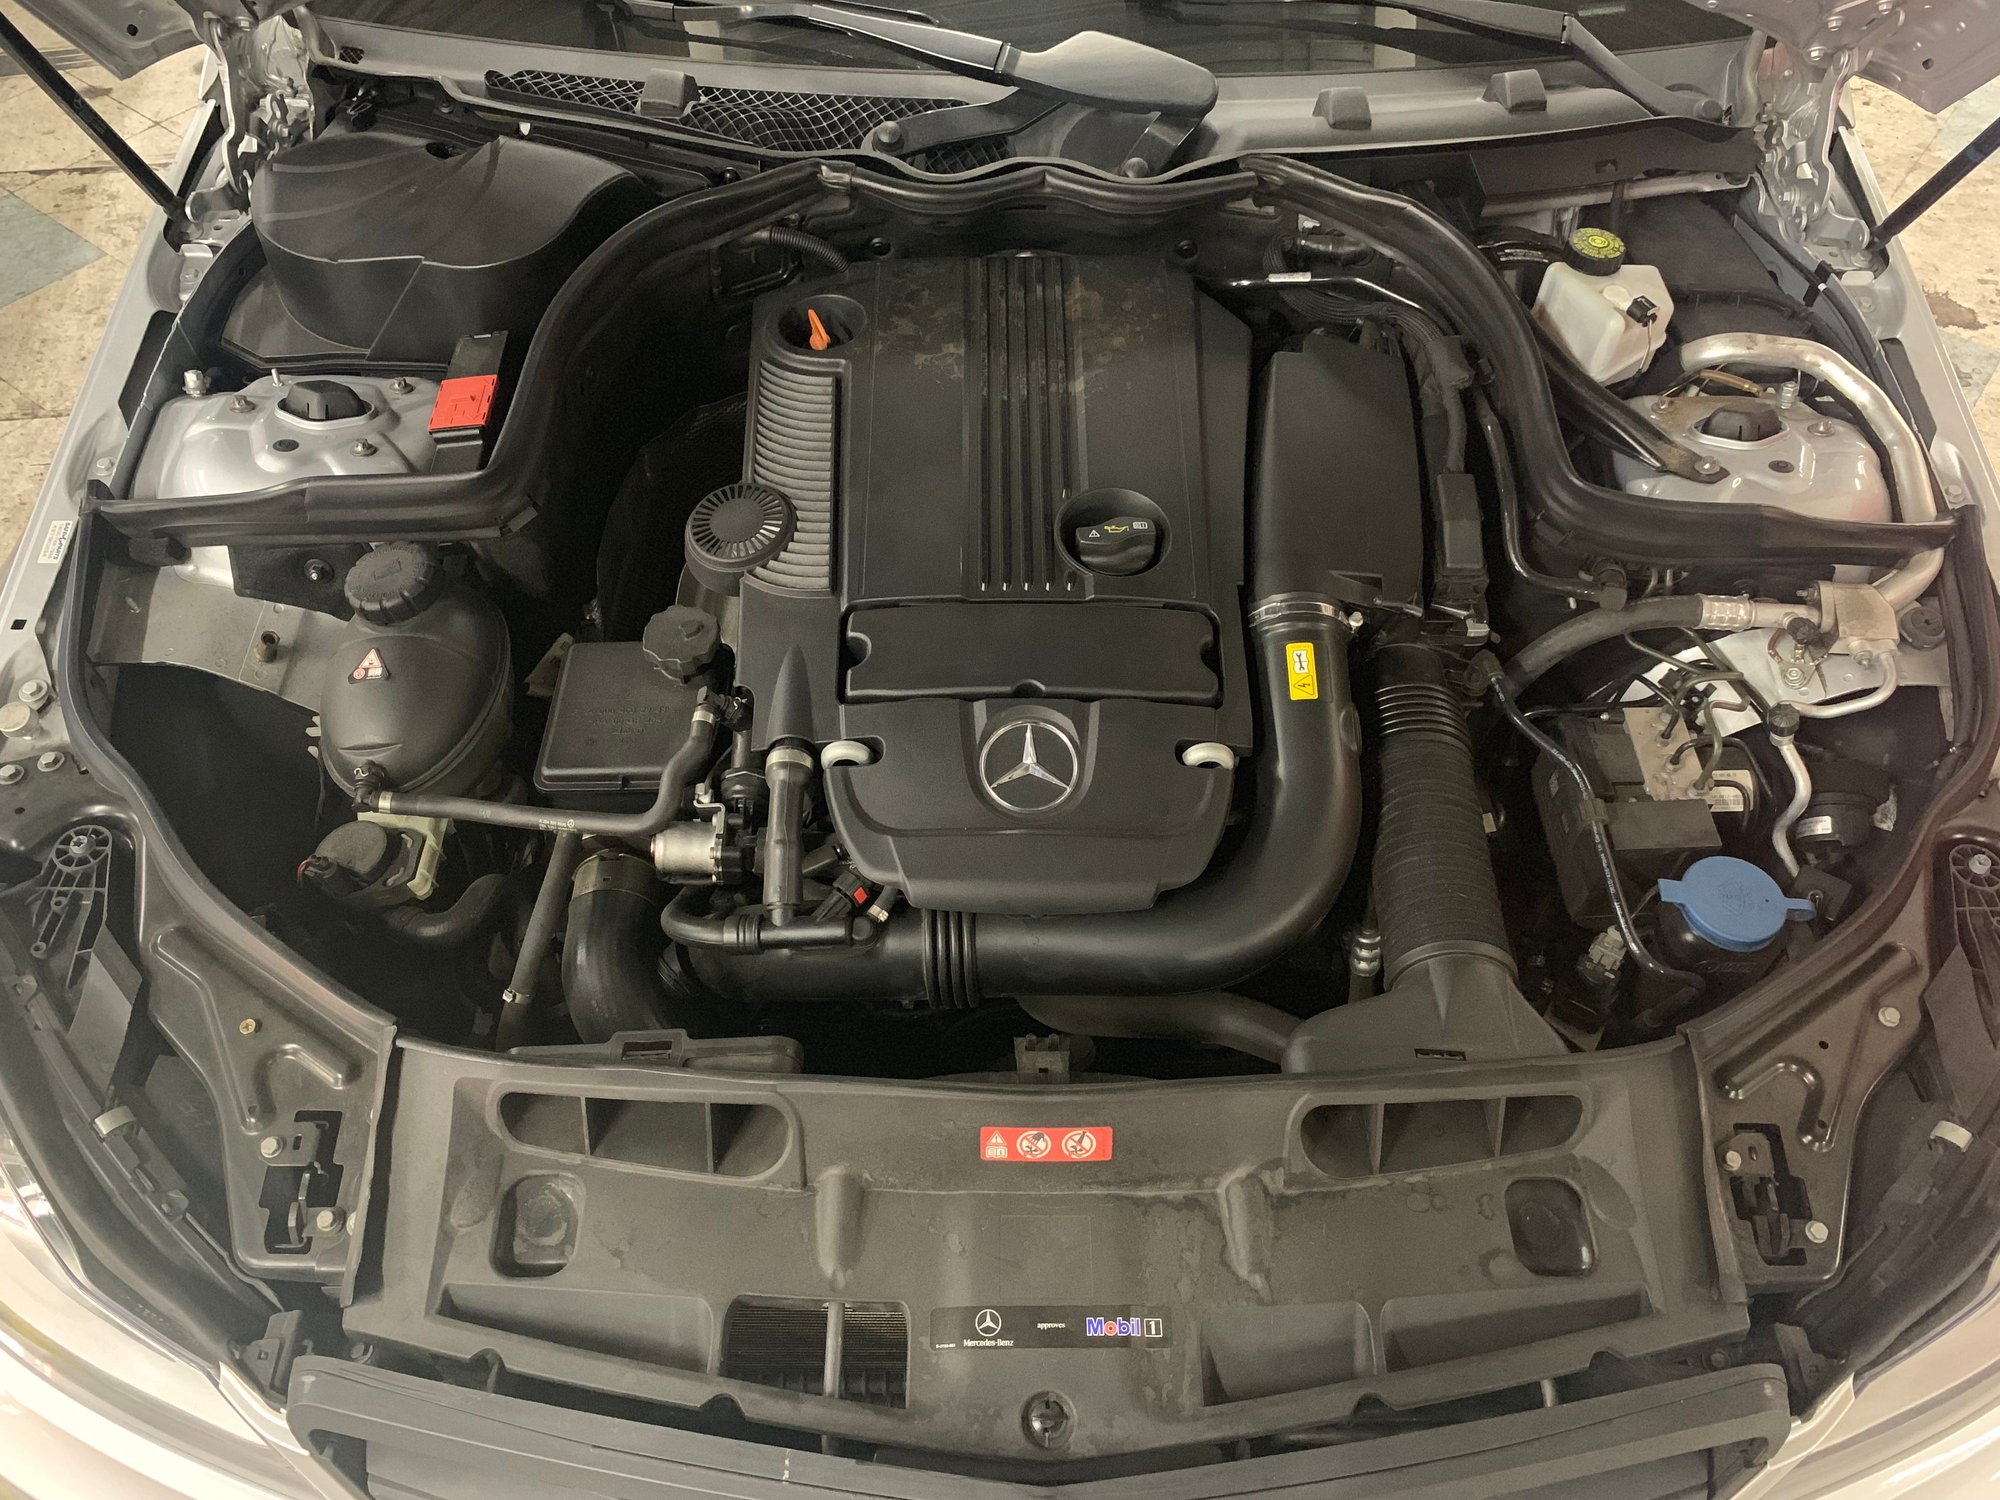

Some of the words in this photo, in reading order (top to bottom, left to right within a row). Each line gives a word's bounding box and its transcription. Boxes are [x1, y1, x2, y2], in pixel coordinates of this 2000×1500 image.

[1037, 1322, 1066, 1330] approves
[1086, 1317, 1141, 1336] Mobil
[963, 1339, 1014, 1347] Mercedes-Benz
